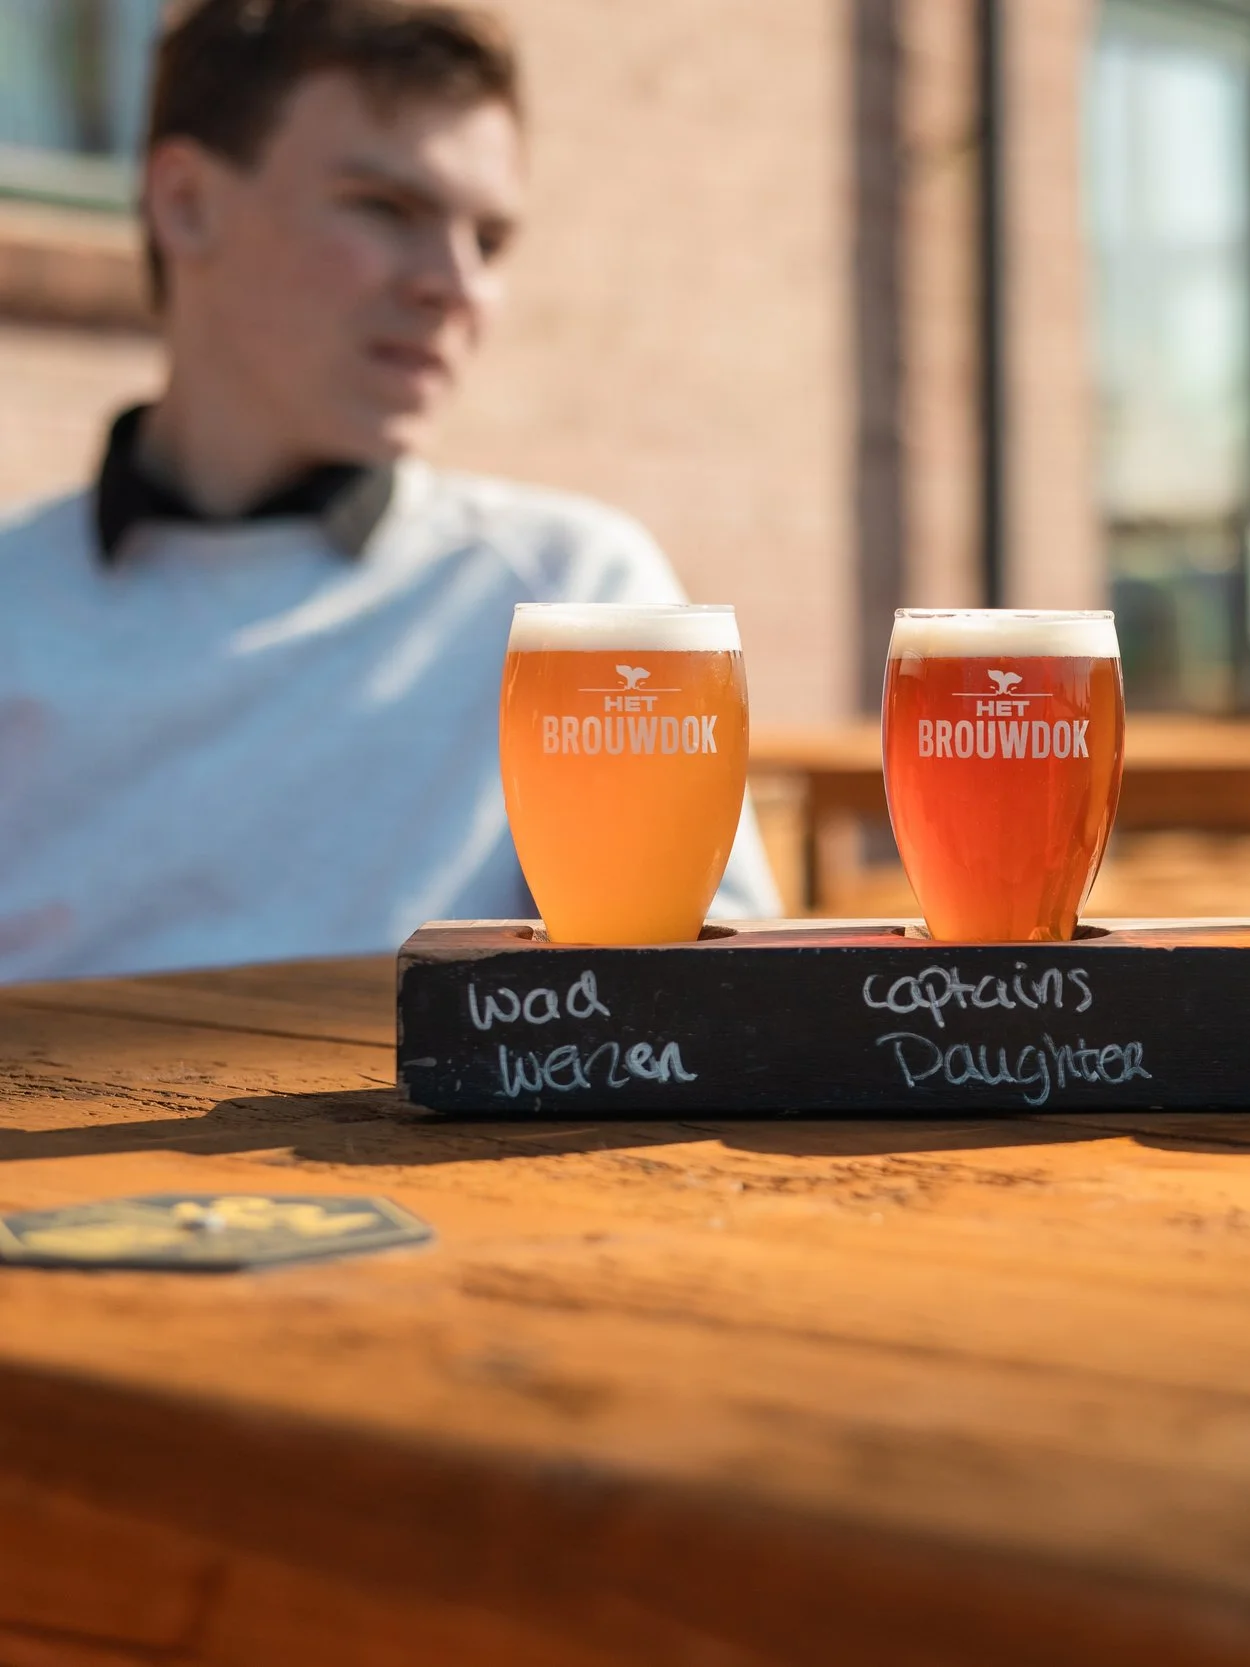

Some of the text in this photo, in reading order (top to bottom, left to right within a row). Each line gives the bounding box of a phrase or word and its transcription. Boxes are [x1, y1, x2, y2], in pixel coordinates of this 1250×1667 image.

[604, 696, 659, 713] HET
[976, 700, 1030, 717] HET
[542, 715, 718, 755] BROUWDOK
[918, 719, 1090, 759] BROUWDOK
